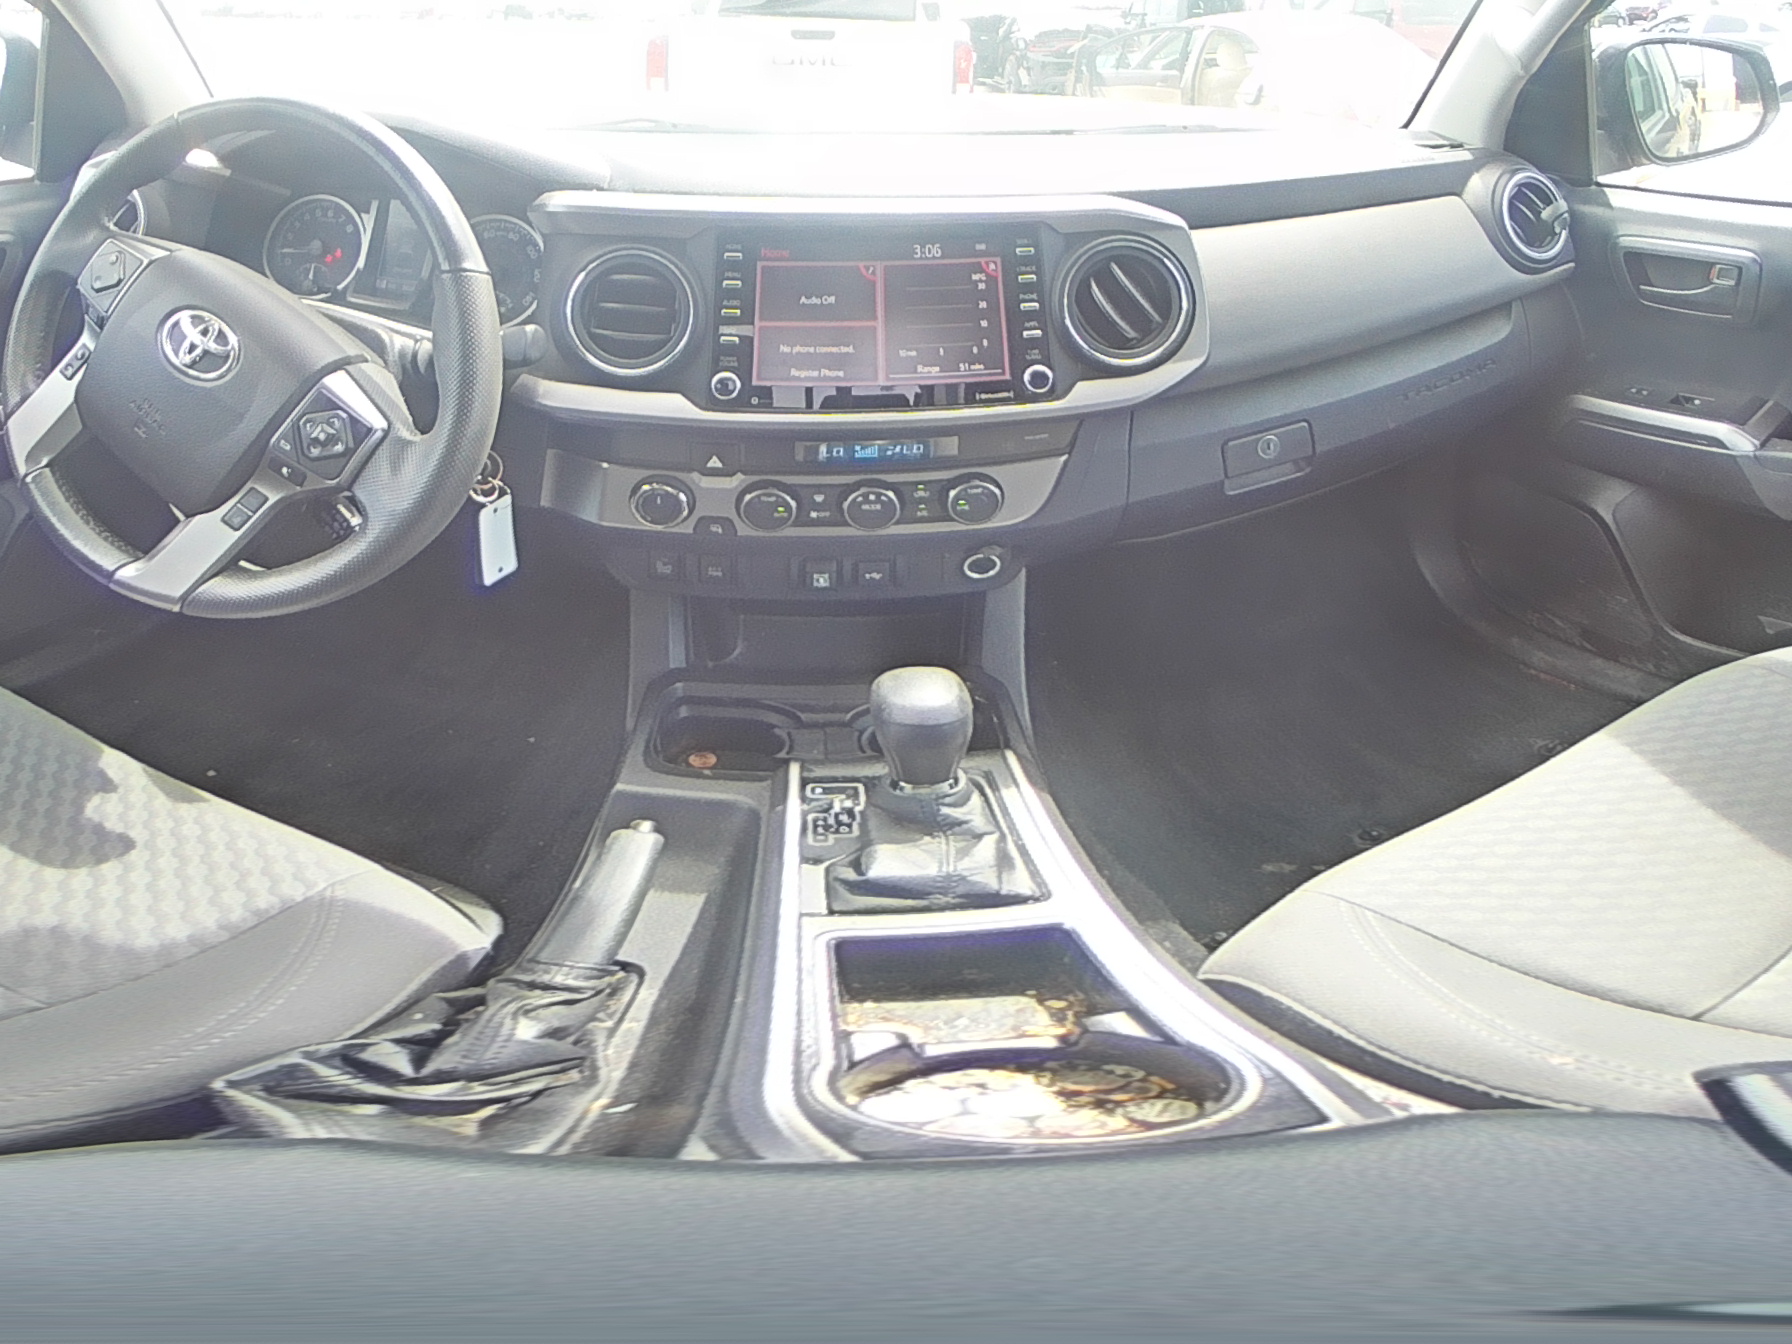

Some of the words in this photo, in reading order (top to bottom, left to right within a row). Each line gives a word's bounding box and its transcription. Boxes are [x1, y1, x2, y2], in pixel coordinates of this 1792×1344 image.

[761, 247, 790, 258] Home
[913, 244, 942, 258] 3:06
[971, 273, 987, 281] MPG
[799, 295, 821, 305] Audio
[822, 295, 836, 304] Off
[978, 301, 987, 309] 20
[779, 344, 791, 353] No
[792, 345, 815, 355] phone
[816, 344, 856, 354] connected.
[790, 368, 819, 378] Register
[820, 368, 844, 377] Phone
[917, 364, 940, 373] Range
[959, 363, 969, 371] 51
[1395, 357, 1497, 402] TACOMA
